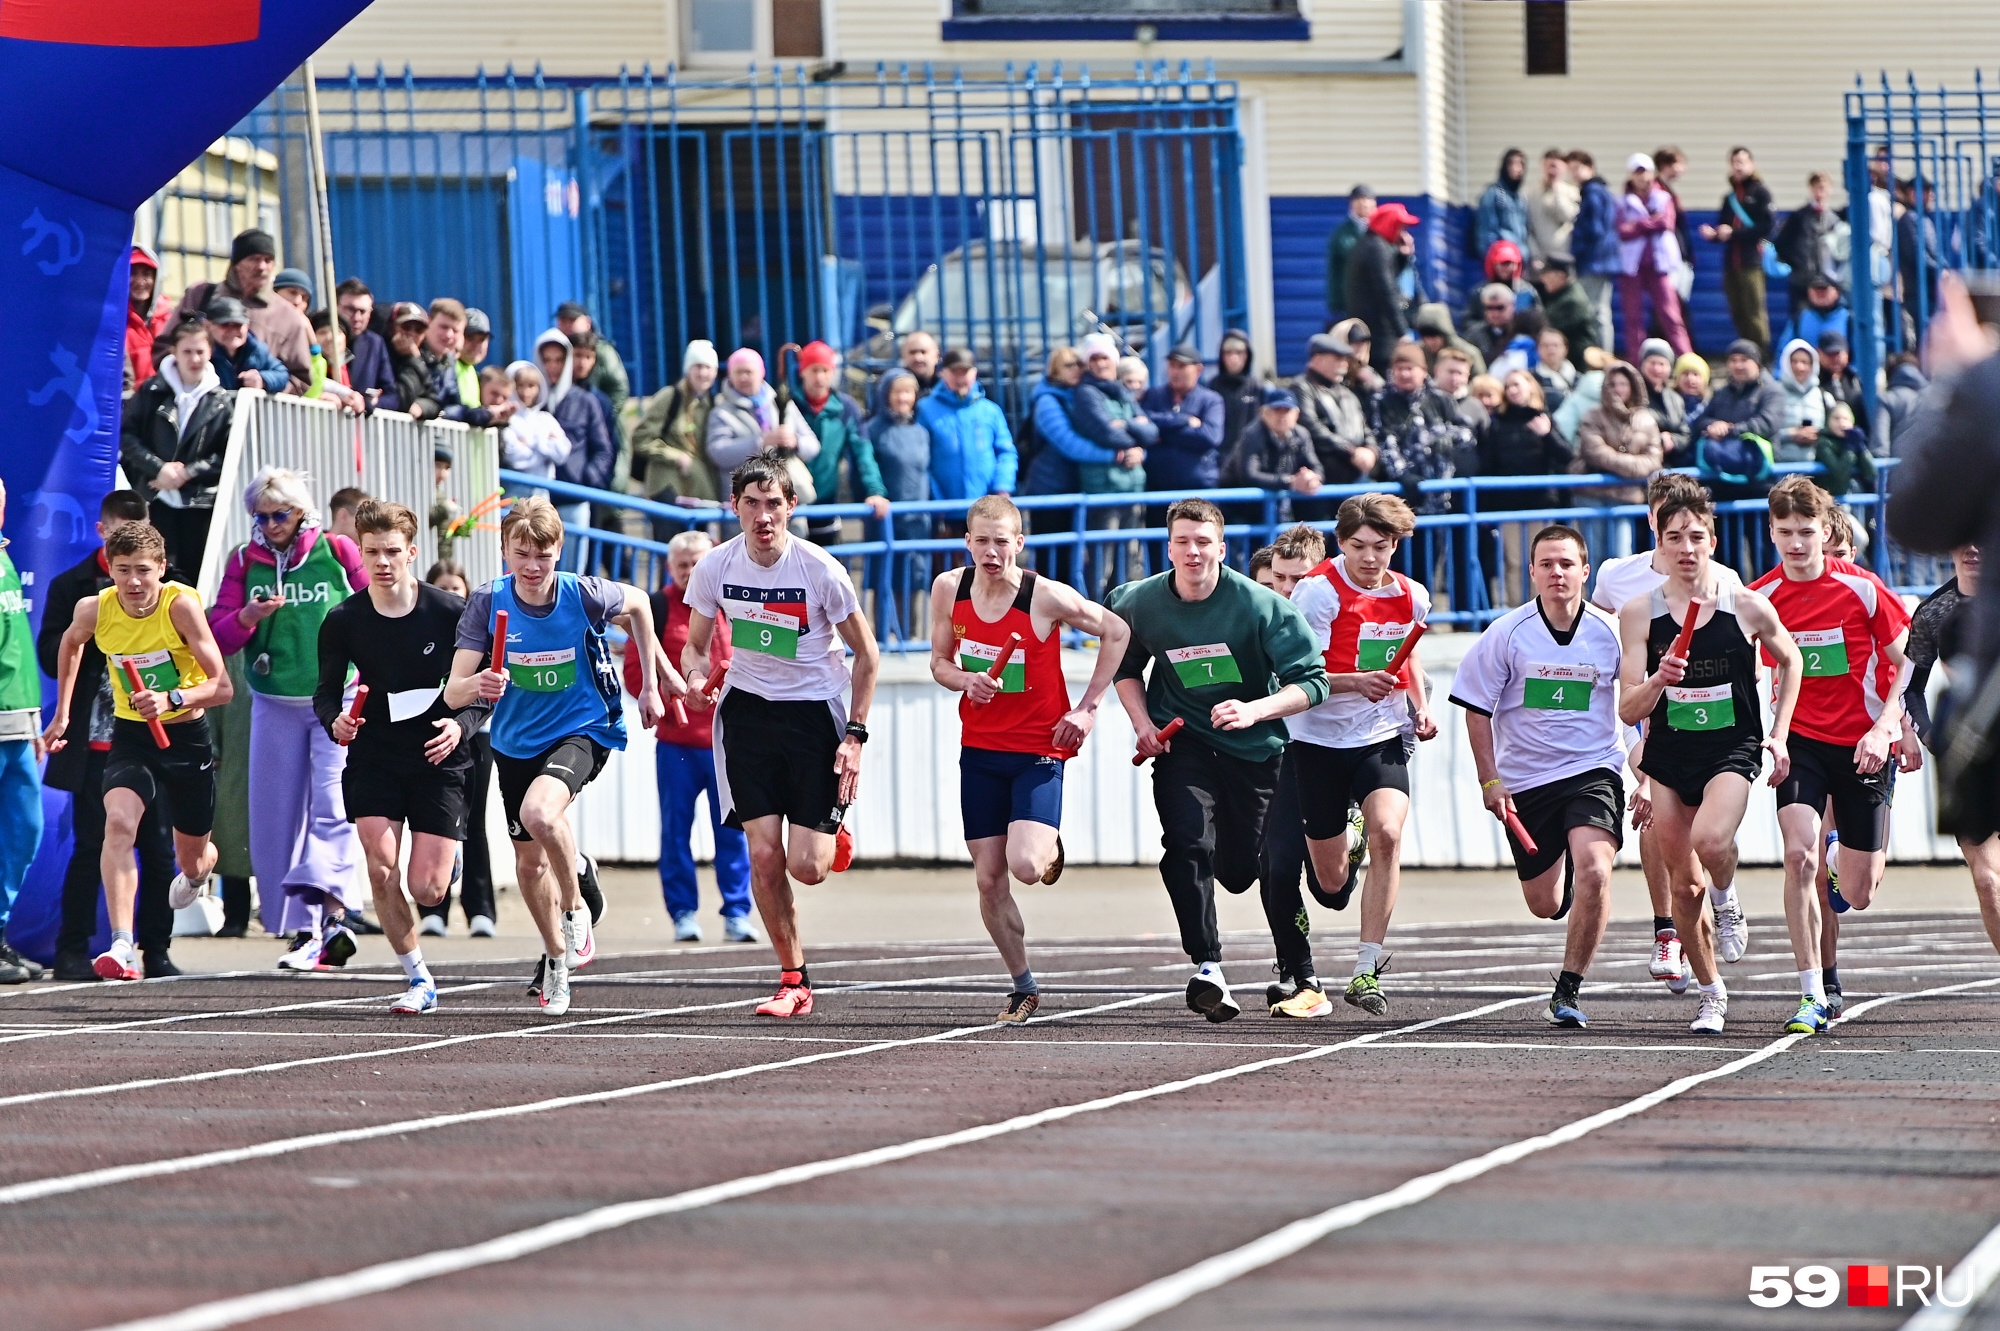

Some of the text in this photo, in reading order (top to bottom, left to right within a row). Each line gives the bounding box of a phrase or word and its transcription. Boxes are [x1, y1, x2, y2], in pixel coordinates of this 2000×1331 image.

[727, 587, 802, 601] TOMMY
[760, 629, 772, 646] 9
[1386, 646, 1397, 662] 6
[1808, 653, 1822, 669] 2
[533, 671, 558, 686] 10
[1201, 663, 1213, 678] 7
[1552, 687, 1564, 703] 4
[1695, 708, 1708, 724] 3
